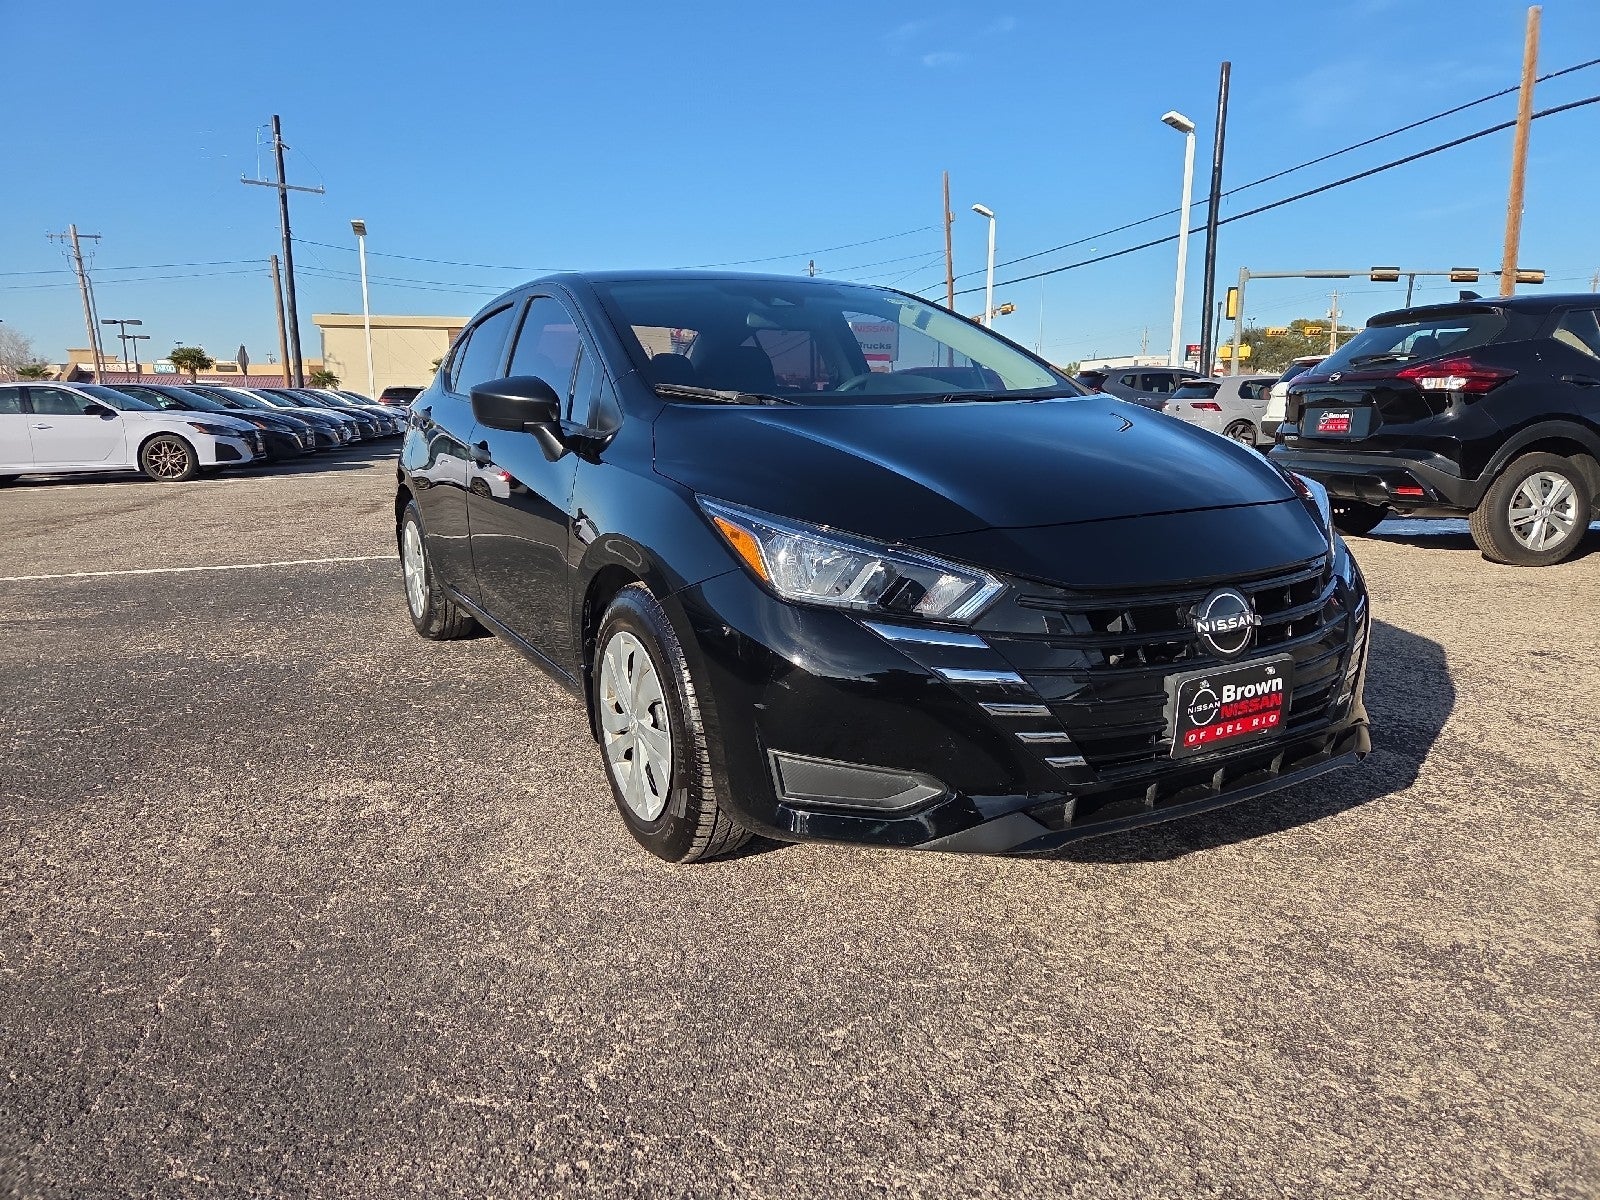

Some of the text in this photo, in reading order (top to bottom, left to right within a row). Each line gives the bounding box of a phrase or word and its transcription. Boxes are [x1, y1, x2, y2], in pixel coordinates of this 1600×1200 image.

[854, 325, 895, 333] NISSAN
[859, 342, 892, 350] Trucks
[1197, 613, 1254, 633] NISSAN
[1222, 677, 1283, 704] Brown
[1187, 700, 1221, 715] NISSAN
[1220, 693, 1283, 719] NISSAN
[1188, 714, 1277, 743] OF DEL RIO
